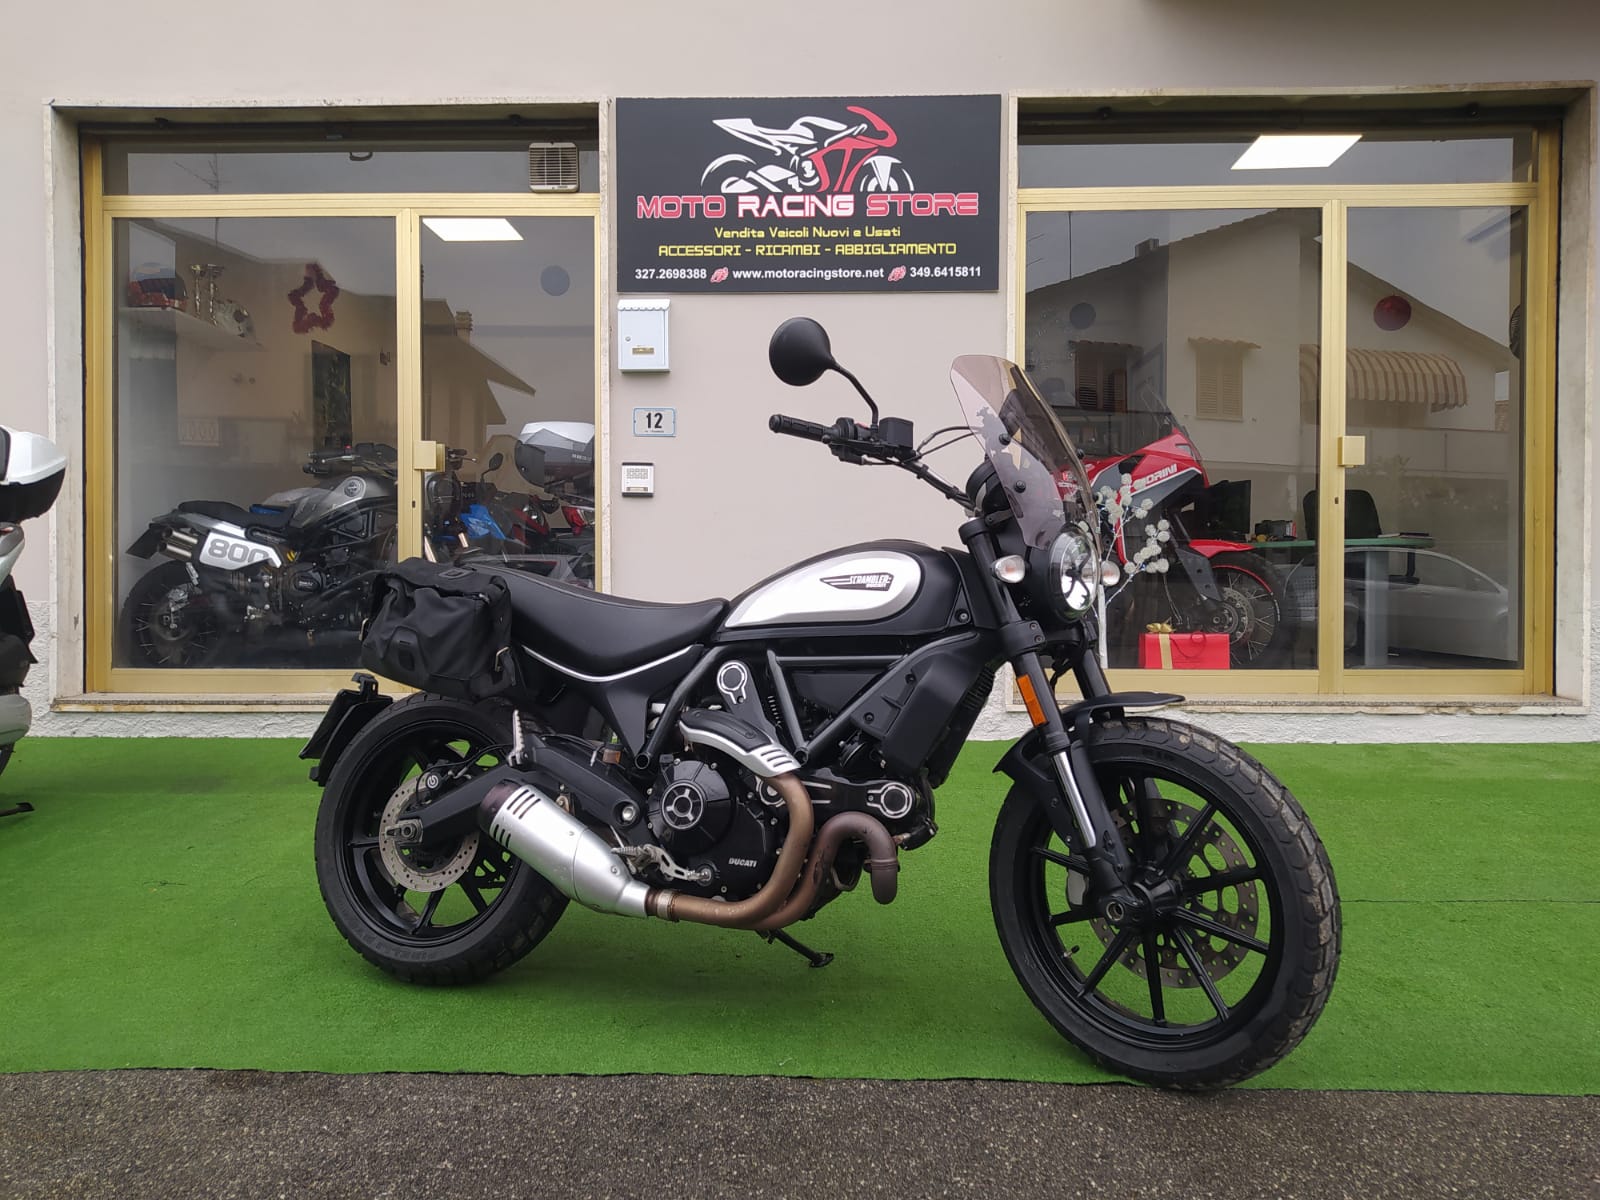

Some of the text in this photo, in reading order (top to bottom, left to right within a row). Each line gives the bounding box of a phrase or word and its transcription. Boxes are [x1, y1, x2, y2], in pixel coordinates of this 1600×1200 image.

[637, 192, 979, 219] MOTO RACING STORE
[714, 225, 901, 239] Vendita Veicoli Nuovi e Usati
[658, 244, 741, 257] ACCESSORI
[755, 244, 821, 256] RICAMBI
[835, 242, 957, 256] ABBIGLIAMENTO
[635, 266, 981, 281] 327.2698388 www.motoracingstore.net 349.6415811
[646, 412, 663, 428] 12
[728, 857, 758, 868] DUCATI
